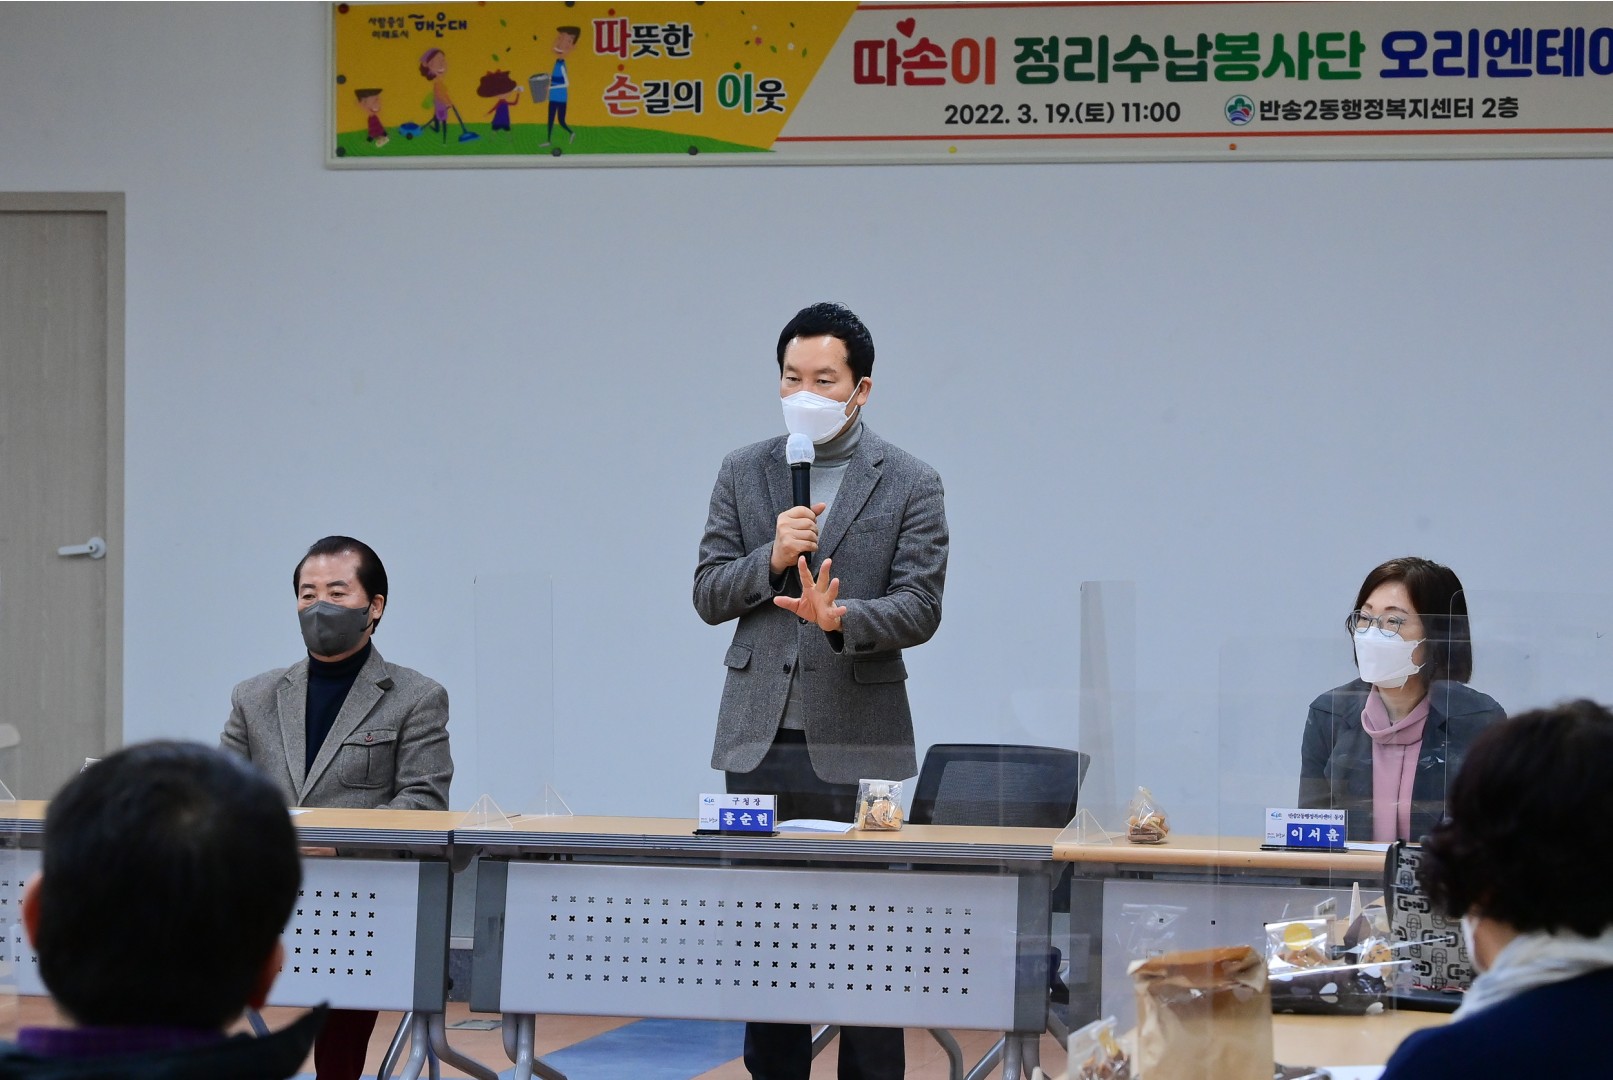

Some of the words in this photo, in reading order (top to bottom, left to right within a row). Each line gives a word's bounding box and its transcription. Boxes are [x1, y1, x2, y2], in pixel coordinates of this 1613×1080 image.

[408, 11, 467, 38] 해운대
[594, 18, 694, 58] 따뜻한
[853, 36, 996, 87] 따손이
[1013, 30, 1366, 85] 정리수납봉사단
[603, 74, 702, 115] 손길의
[716, 73, 786, 115] 이웃
[944, 103, 1010, 125] 2022.
[1017, 103, 1038, 124] 3.
[1121, 101, 1181, 123] 11:00
[1259, 97, 1475, 122] 반송2동행정복지센터
[1482, 96, 1519, 120] 2층
[722, 811, 769, 827] 홍순헌
[1291, 826, 1340, 842] 이서윤
